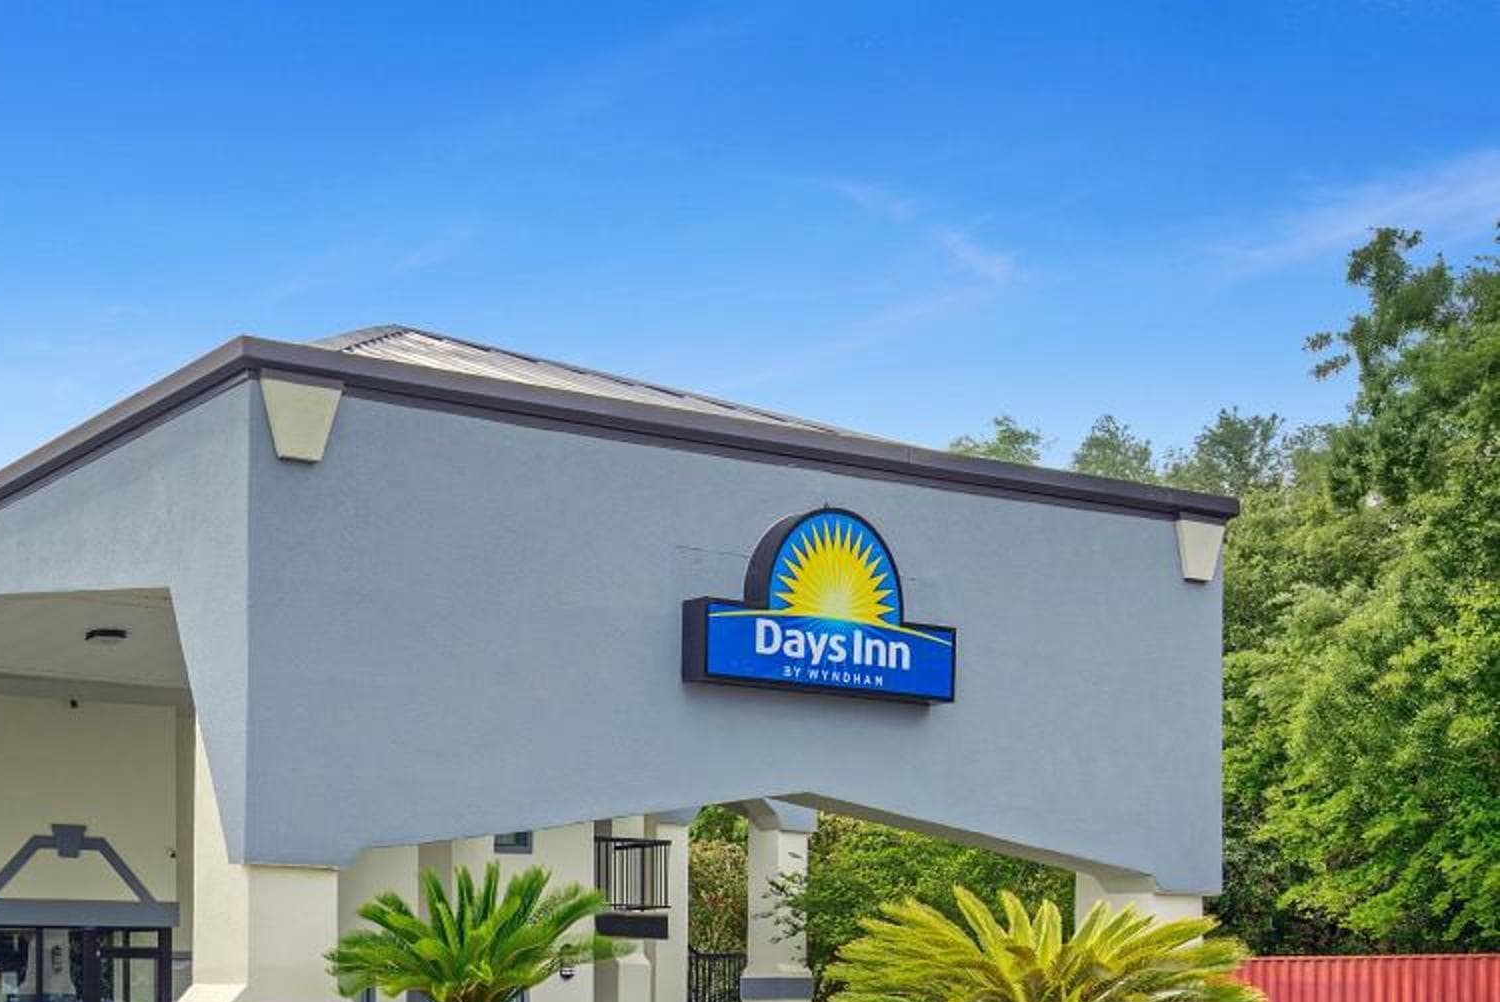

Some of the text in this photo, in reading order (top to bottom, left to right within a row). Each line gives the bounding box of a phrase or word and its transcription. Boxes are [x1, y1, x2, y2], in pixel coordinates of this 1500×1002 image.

[755, 618, 910, 670] Days Inn
[783, 666, 883, 686] BY WYNDHAM
